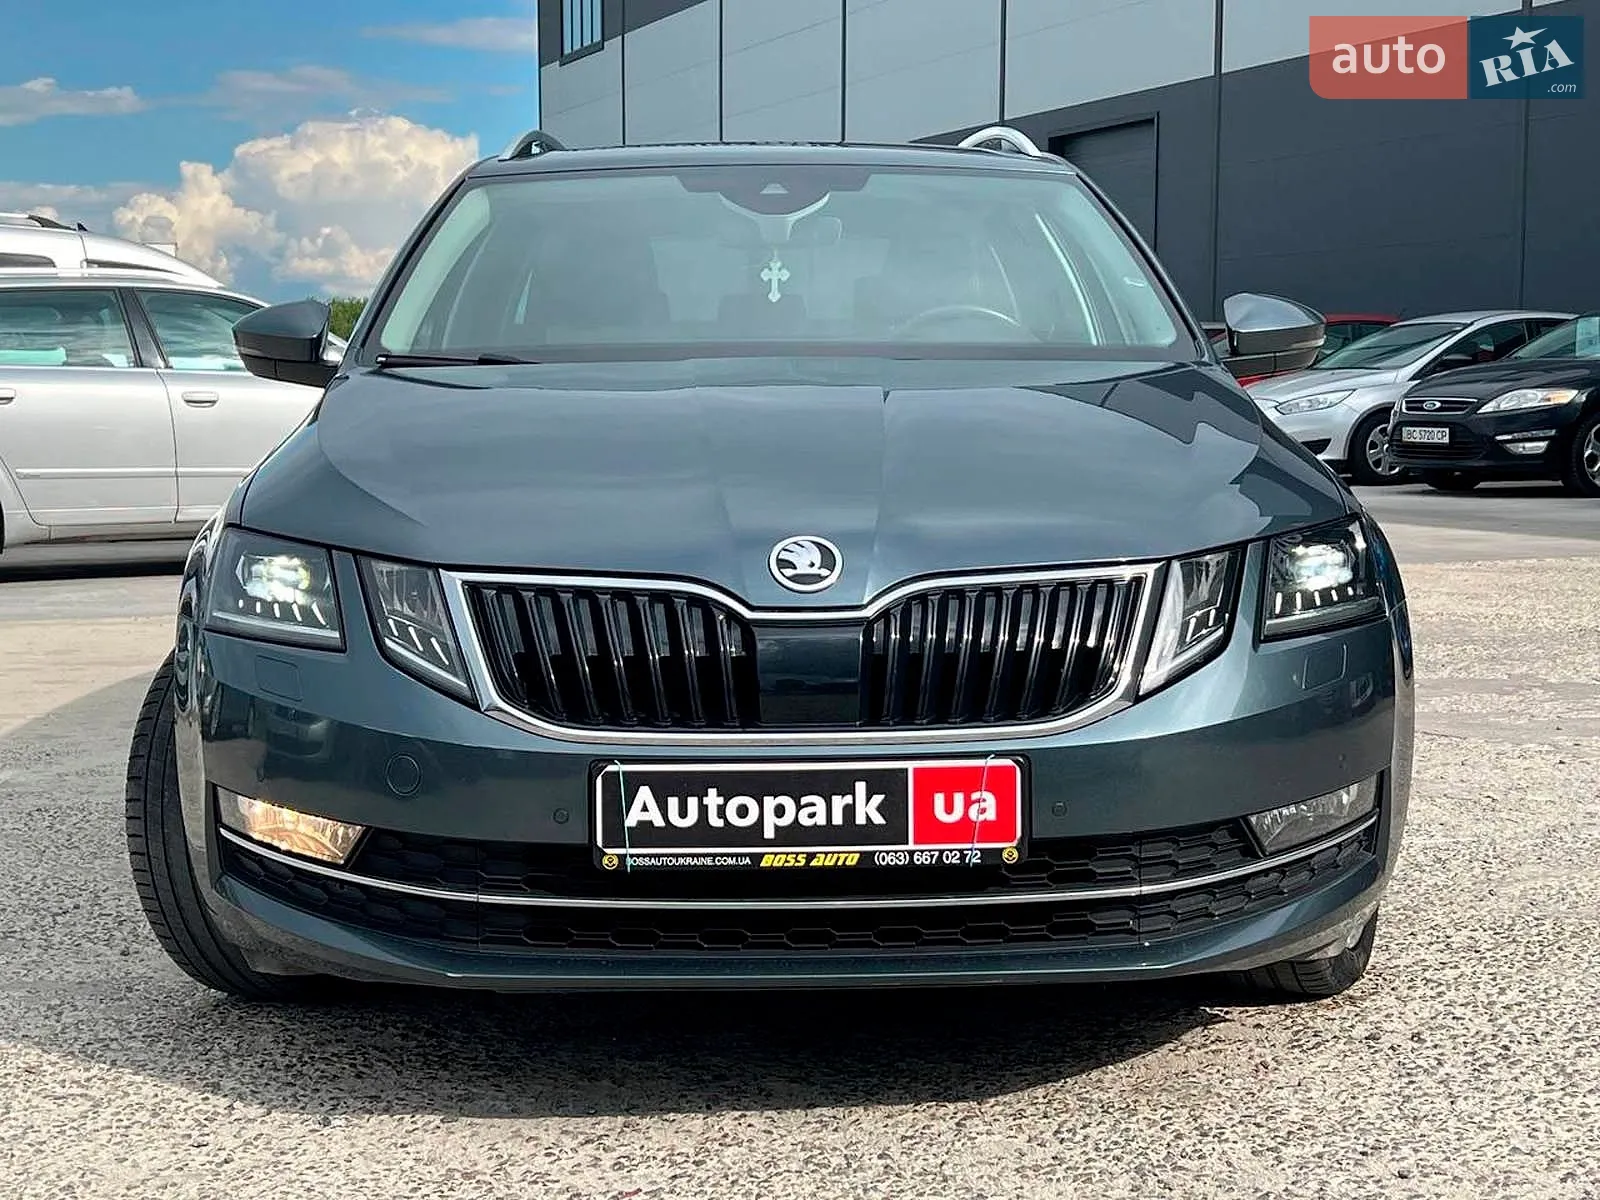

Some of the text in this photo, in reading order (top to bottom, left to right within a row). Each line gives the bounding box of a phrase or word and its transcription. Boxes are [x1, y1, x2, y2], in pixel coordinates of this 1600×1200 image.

[626, 782, 998, 839] Autopark ua
[760, 853, 807, 867] BOSS
[809, 853, 860, 866] AUTO
[874, 851, 909, 865] (063)
[913, 851, 939, 864] 667
[942, 851, 960, 864] 02
[963, 850, 982, 863] 72
